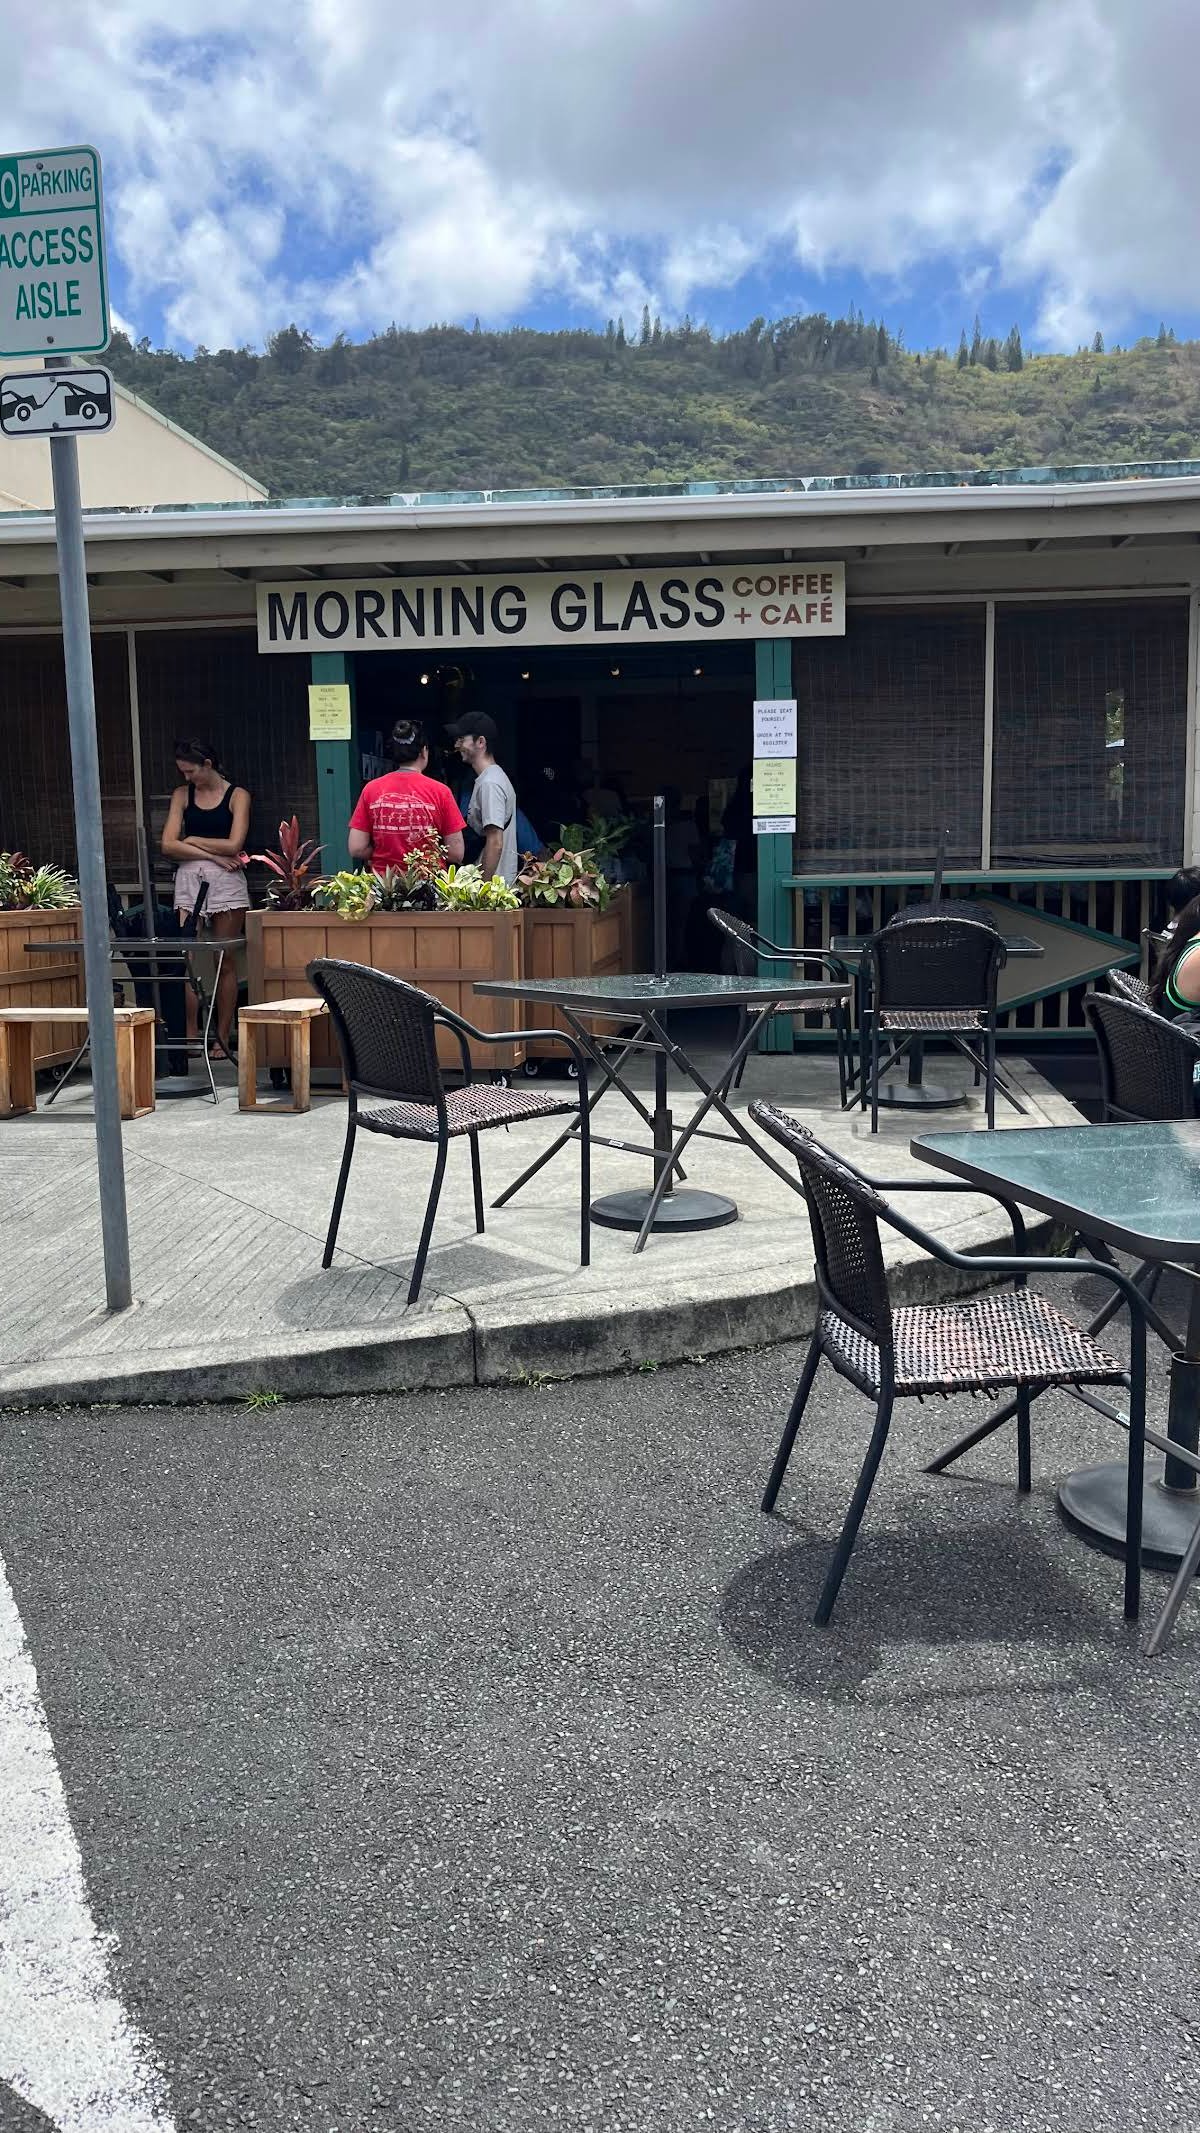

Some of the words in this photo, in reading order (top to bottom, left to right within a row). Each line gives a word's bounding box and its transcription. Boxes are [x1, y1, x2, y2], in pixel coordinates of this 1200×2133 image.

[0, 171, 17, 209] O
[21, 166, 92, 198] PARKING
[0, 225, 93, 269] ACCESS
[16, 280, 81, 320] AISLE
[732, 573, 833, 598] COFFEE
[268, 585, 527, 641] MORNING
[550, 577, 725, 633] GLASS
[734, 607, 752, 625] +
[760, 595, 833, 626] CAFÉ
